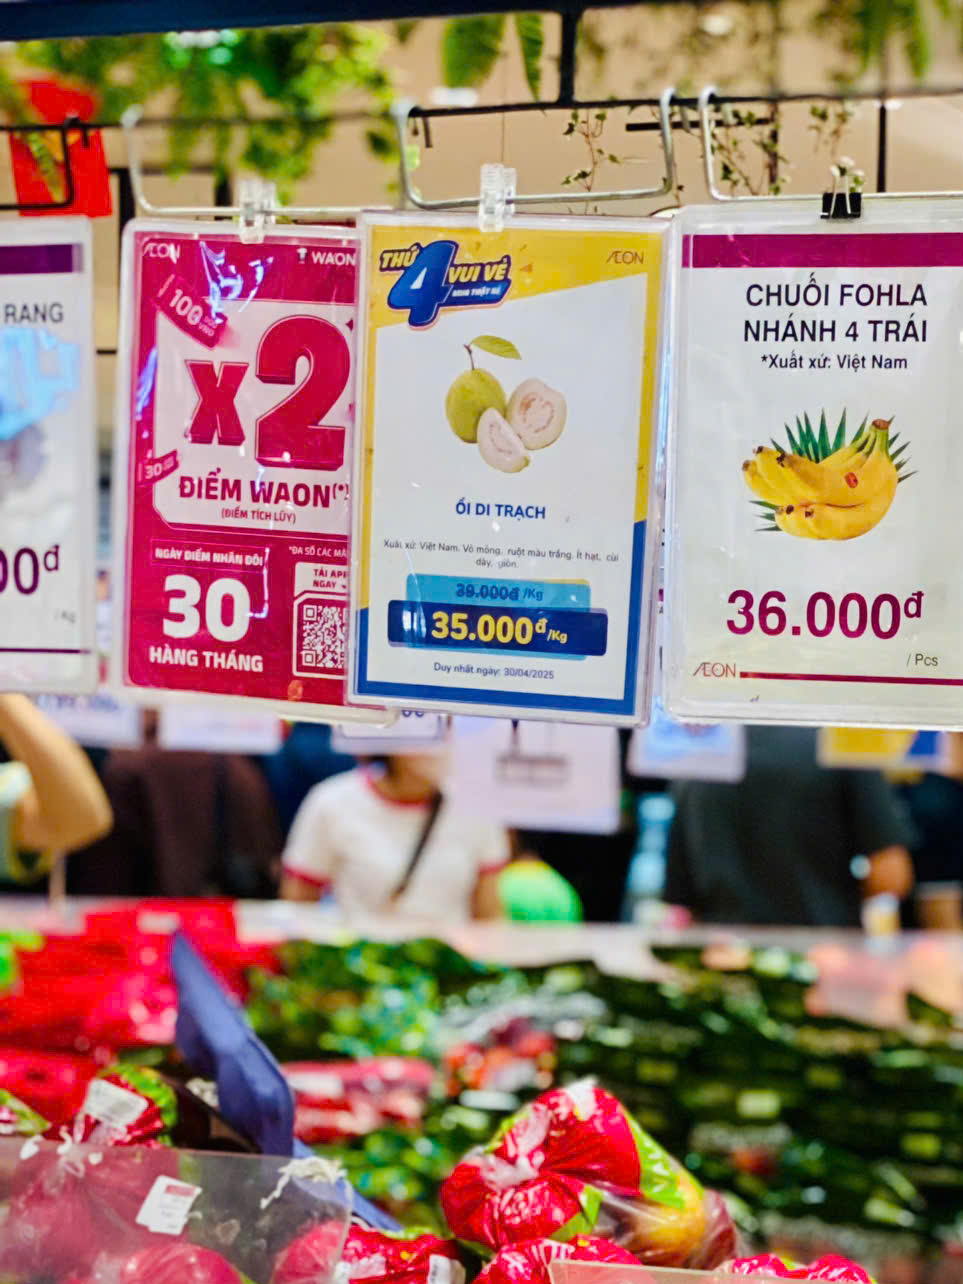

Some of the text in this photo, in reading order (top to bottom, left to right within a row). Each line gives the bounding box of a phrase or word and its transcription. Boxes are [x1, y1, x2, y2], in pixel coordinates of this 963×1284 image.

[311, 252, 356, 266] WAON
[448, 264, 480, 283] VUI
[746, 272, 927, 306] CHUỐI FOHLA
[4, 303, 64, 324] RANG
[744, 313, 927, 342] NHÁNH 4 TRÁI
[808, 356, 831, 369] xứ:
[836, 355, 866, 372] Việt
[872, 355, 907, 369] Nam
[179, 467, 242, 502] ĐIỂM
[475, 503, 491, 516] DI
[495, 504, 546, 520] TRẠCH
[155, 546, 181, 561] NGÀY
[184, 547, 210, 563] ĐIỂM
[213, 550, 242, 566] NHÂN
[522, 587, 543, 601] /Kg
[162, 574, 250, 642] 30
[727, 589, 924, 640] 36.000đ
[431, 611, 547, 645] 35.000đ
[150, 644, 263, 672] HÀNG THÁNG
[914, 654, 939, 667] Pcs
[434, 662, 451, 675] Duy
[454, 664, 474, 675] nhất
[504, 667, 555, 680] 30/04/2025
